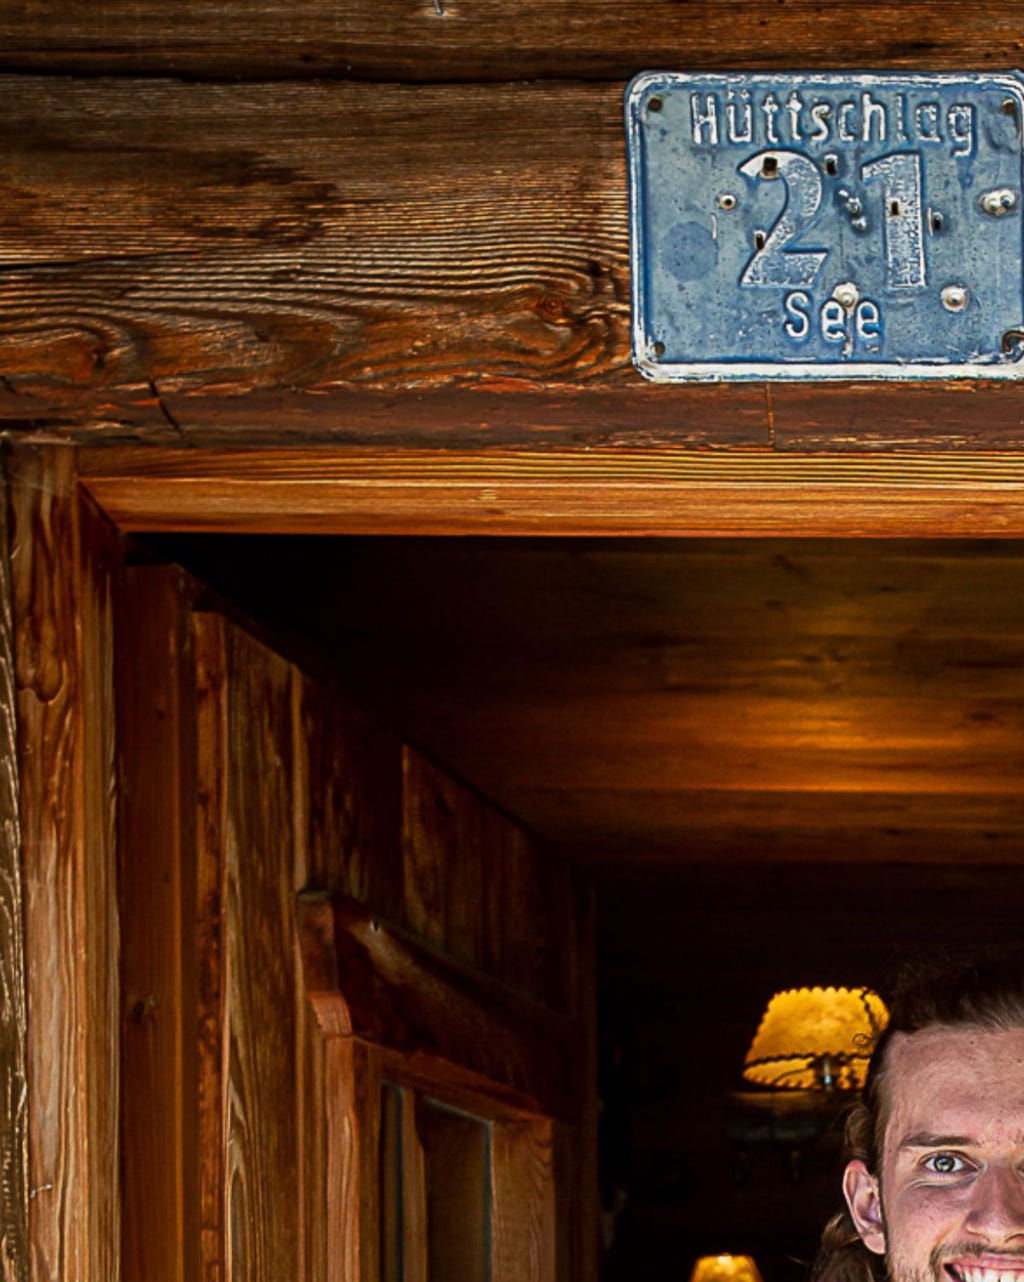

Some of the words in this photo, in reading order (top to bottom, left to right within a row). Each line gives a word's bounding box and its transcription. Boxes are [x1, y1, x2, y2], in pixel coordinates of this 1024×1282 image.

[690, 90, 977, 157] Hüttschlag
[738, 150, 927, 289] 21
[784, 291, 881, 340] See
